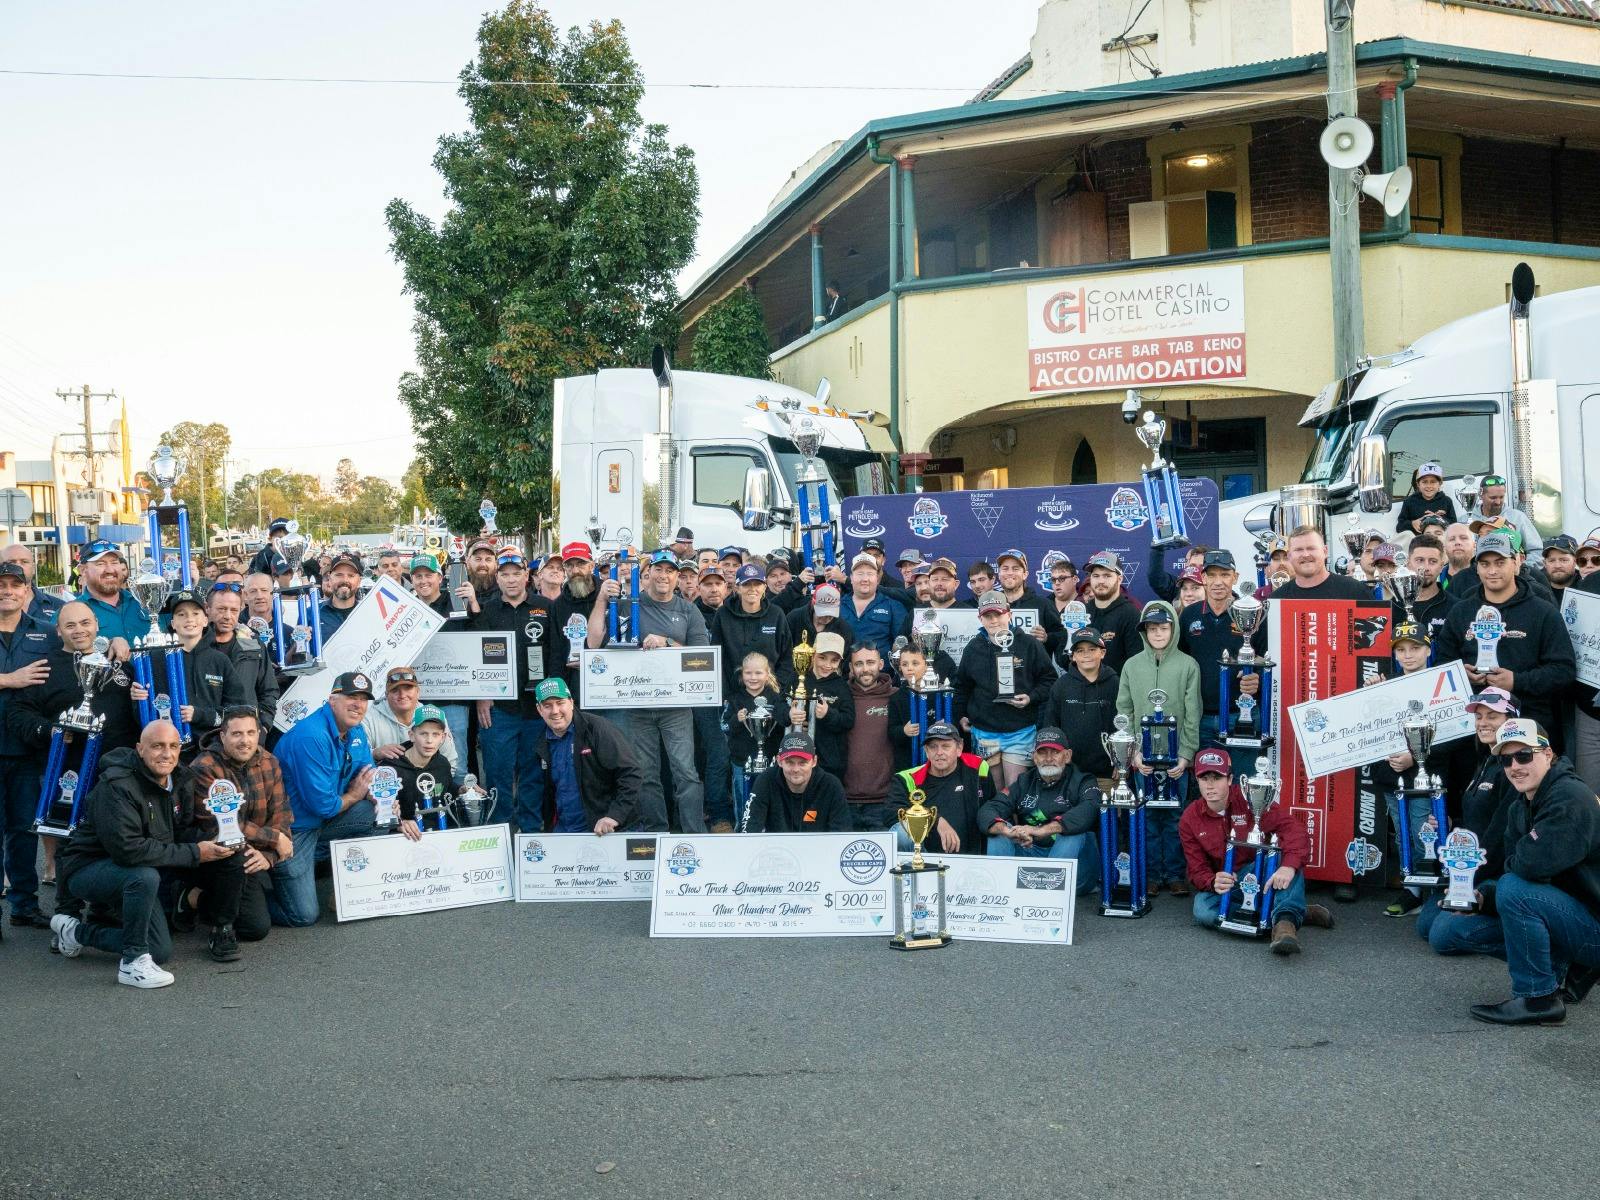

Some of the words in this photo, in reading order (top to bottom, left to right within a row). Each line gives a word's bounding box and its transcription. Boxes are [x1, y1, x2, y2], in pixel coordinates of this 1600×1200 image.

[1087, 281, 1213, 305] COMMERCIAL
[1088, 304, 1143, 324] HOTEL
[1155, 298, 1230, 317] CASINO
[1034, 350, 1081, 365] BISTRO
[1088, 346, 1123, 360] CAFE
[1132, 343, 1160, 357] BAR
[1167, 340, 1194, 354] TAB
[1204, 337, 1242, 352] KENO
[1036, 355, 1242, 388] ACCOMMODATION
[1037, 504, 1072, 513] PETROLEUM
[1107, 508, 1149, 519] TRUCK
[909, 517, 946, 527] TRUCK
[385, 603, 408, 631] AMPOL
[1308, 612, 1317, 645] FIVE
[360, 638, 381, 665] 2025
[471, 670, 477, 680] $
[613, 675, 628, 686] Best
[1308, 649, 1318, 701] THOUS
[678, 683, 685, 692] $
[687, 682, 704, 692] 300
[1356, 721, 1372, 733] 3rd
[1395, 709, 1413, 722] 202
[1434, 708, 1453, 722] 600
[1359, 790, 1376, 835] AWARD
[459, 836, 500, 852] ROBUK
[844, 841, 882, 860] COUNTRY
[343, 857, 370, 867] TRUCK
[1443, 849, 1483, 861] TRUCK
[666, 858, 701, 868] TRUCK
[462, 873, 470, 885] $
[473, 869, 495, 882] 500
[623, 872, 630, 882] $
[634, 871, 651, 881] 300
[678, 883, 701, 896] Show
[704, 882, 729, 895] Truck
[731, 881, 784, 896] Champions
[787, 881, 820, 893] 2025
[824, 892, 834, 909] $
[841, 892, 869, 908] 900
[956, 893, 978, 906] Lights
[980, 895, 1010, 905] 2025
[712, 903, 734, 916] Nine
[737, 902, 776, 916] Hundred
[778, 902, 813, 916] Dollars
[1013, 907, 1021, 918] $
[1026, 908, 1049, 918] 300
